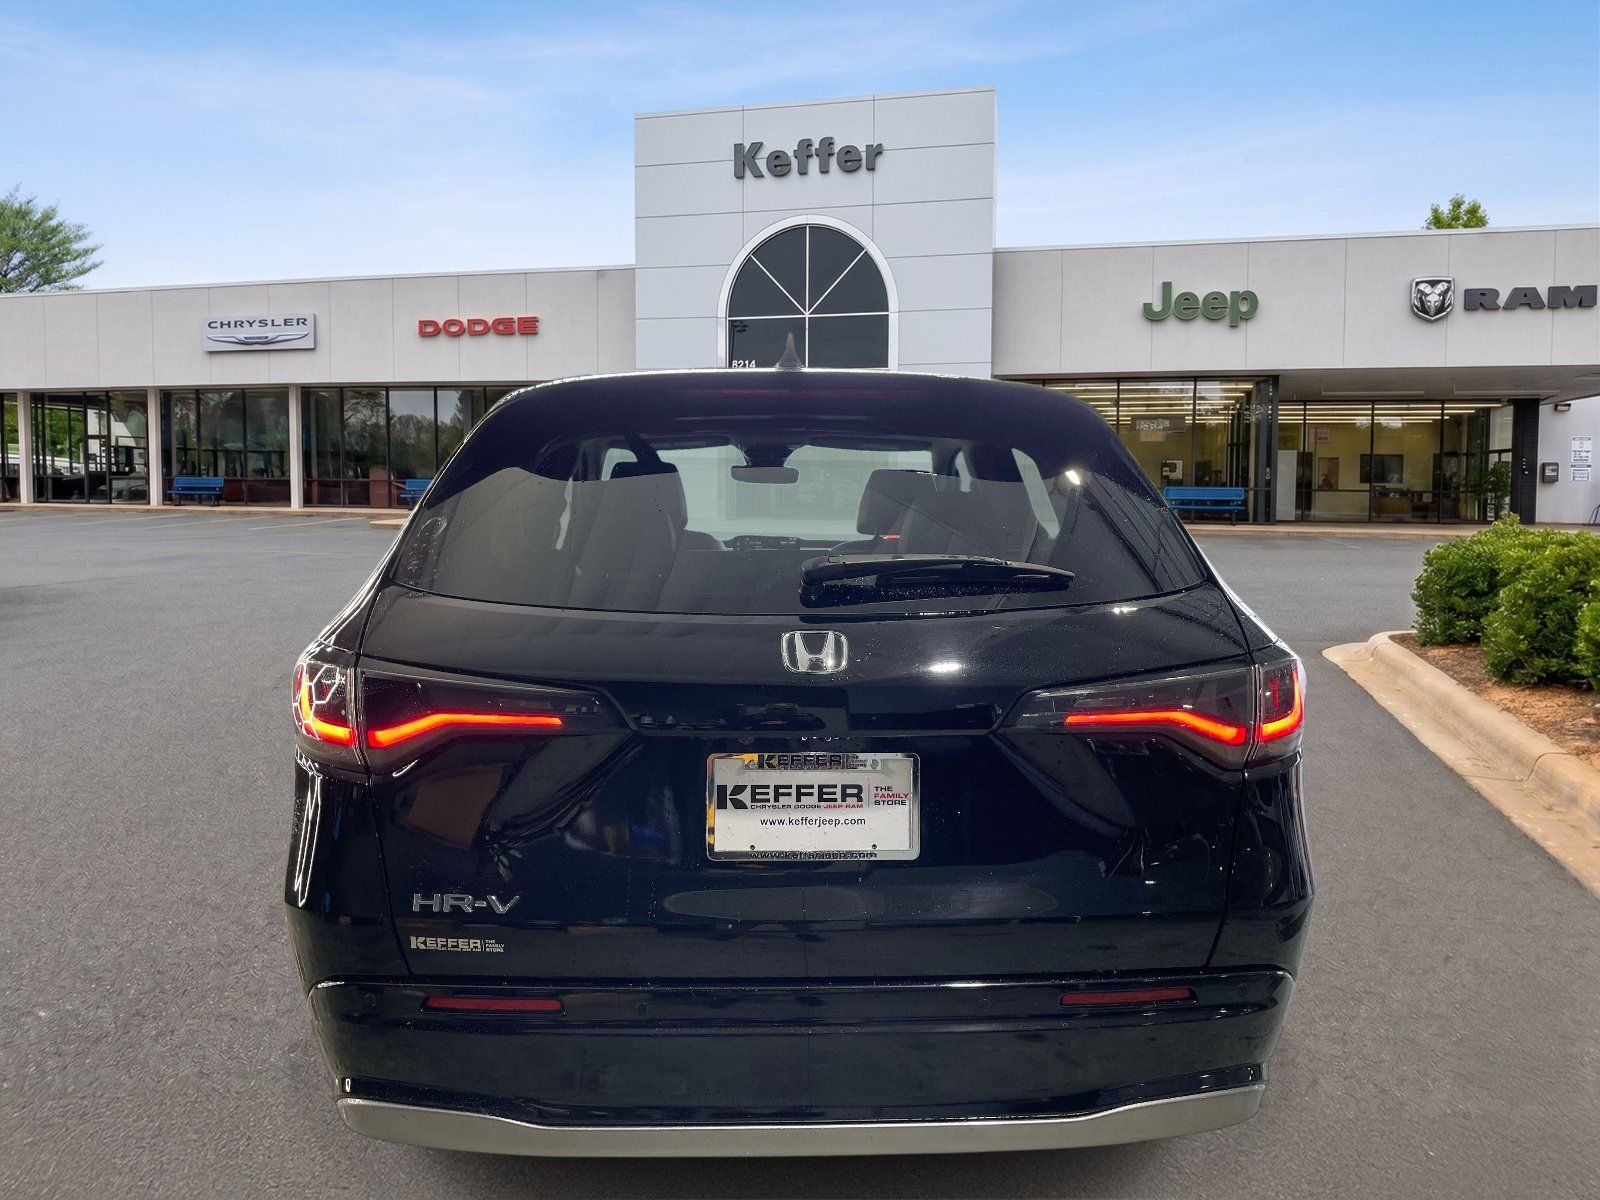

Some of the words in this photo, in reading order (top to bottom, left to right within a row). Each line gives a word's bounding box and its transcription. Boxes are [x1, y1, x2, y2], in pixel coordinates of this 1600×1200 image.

[733, 137, 883, 179] Keffer
[1143, 281, 1259, 328] Jeep
[1464, 285, 1598, 311] RAM
[207, 317, 308, 329] CHRYSLER
[418, 316, 540, 337] DODGE
[731, 360, 757, 369] 8214
[716, 784, 864, 809] KEFFER
[760, 816, 866, 828] www.kefferjeep.com
[412, 893, 520, 914] HR-V
[410, 936, 481, 949] KEFFER
